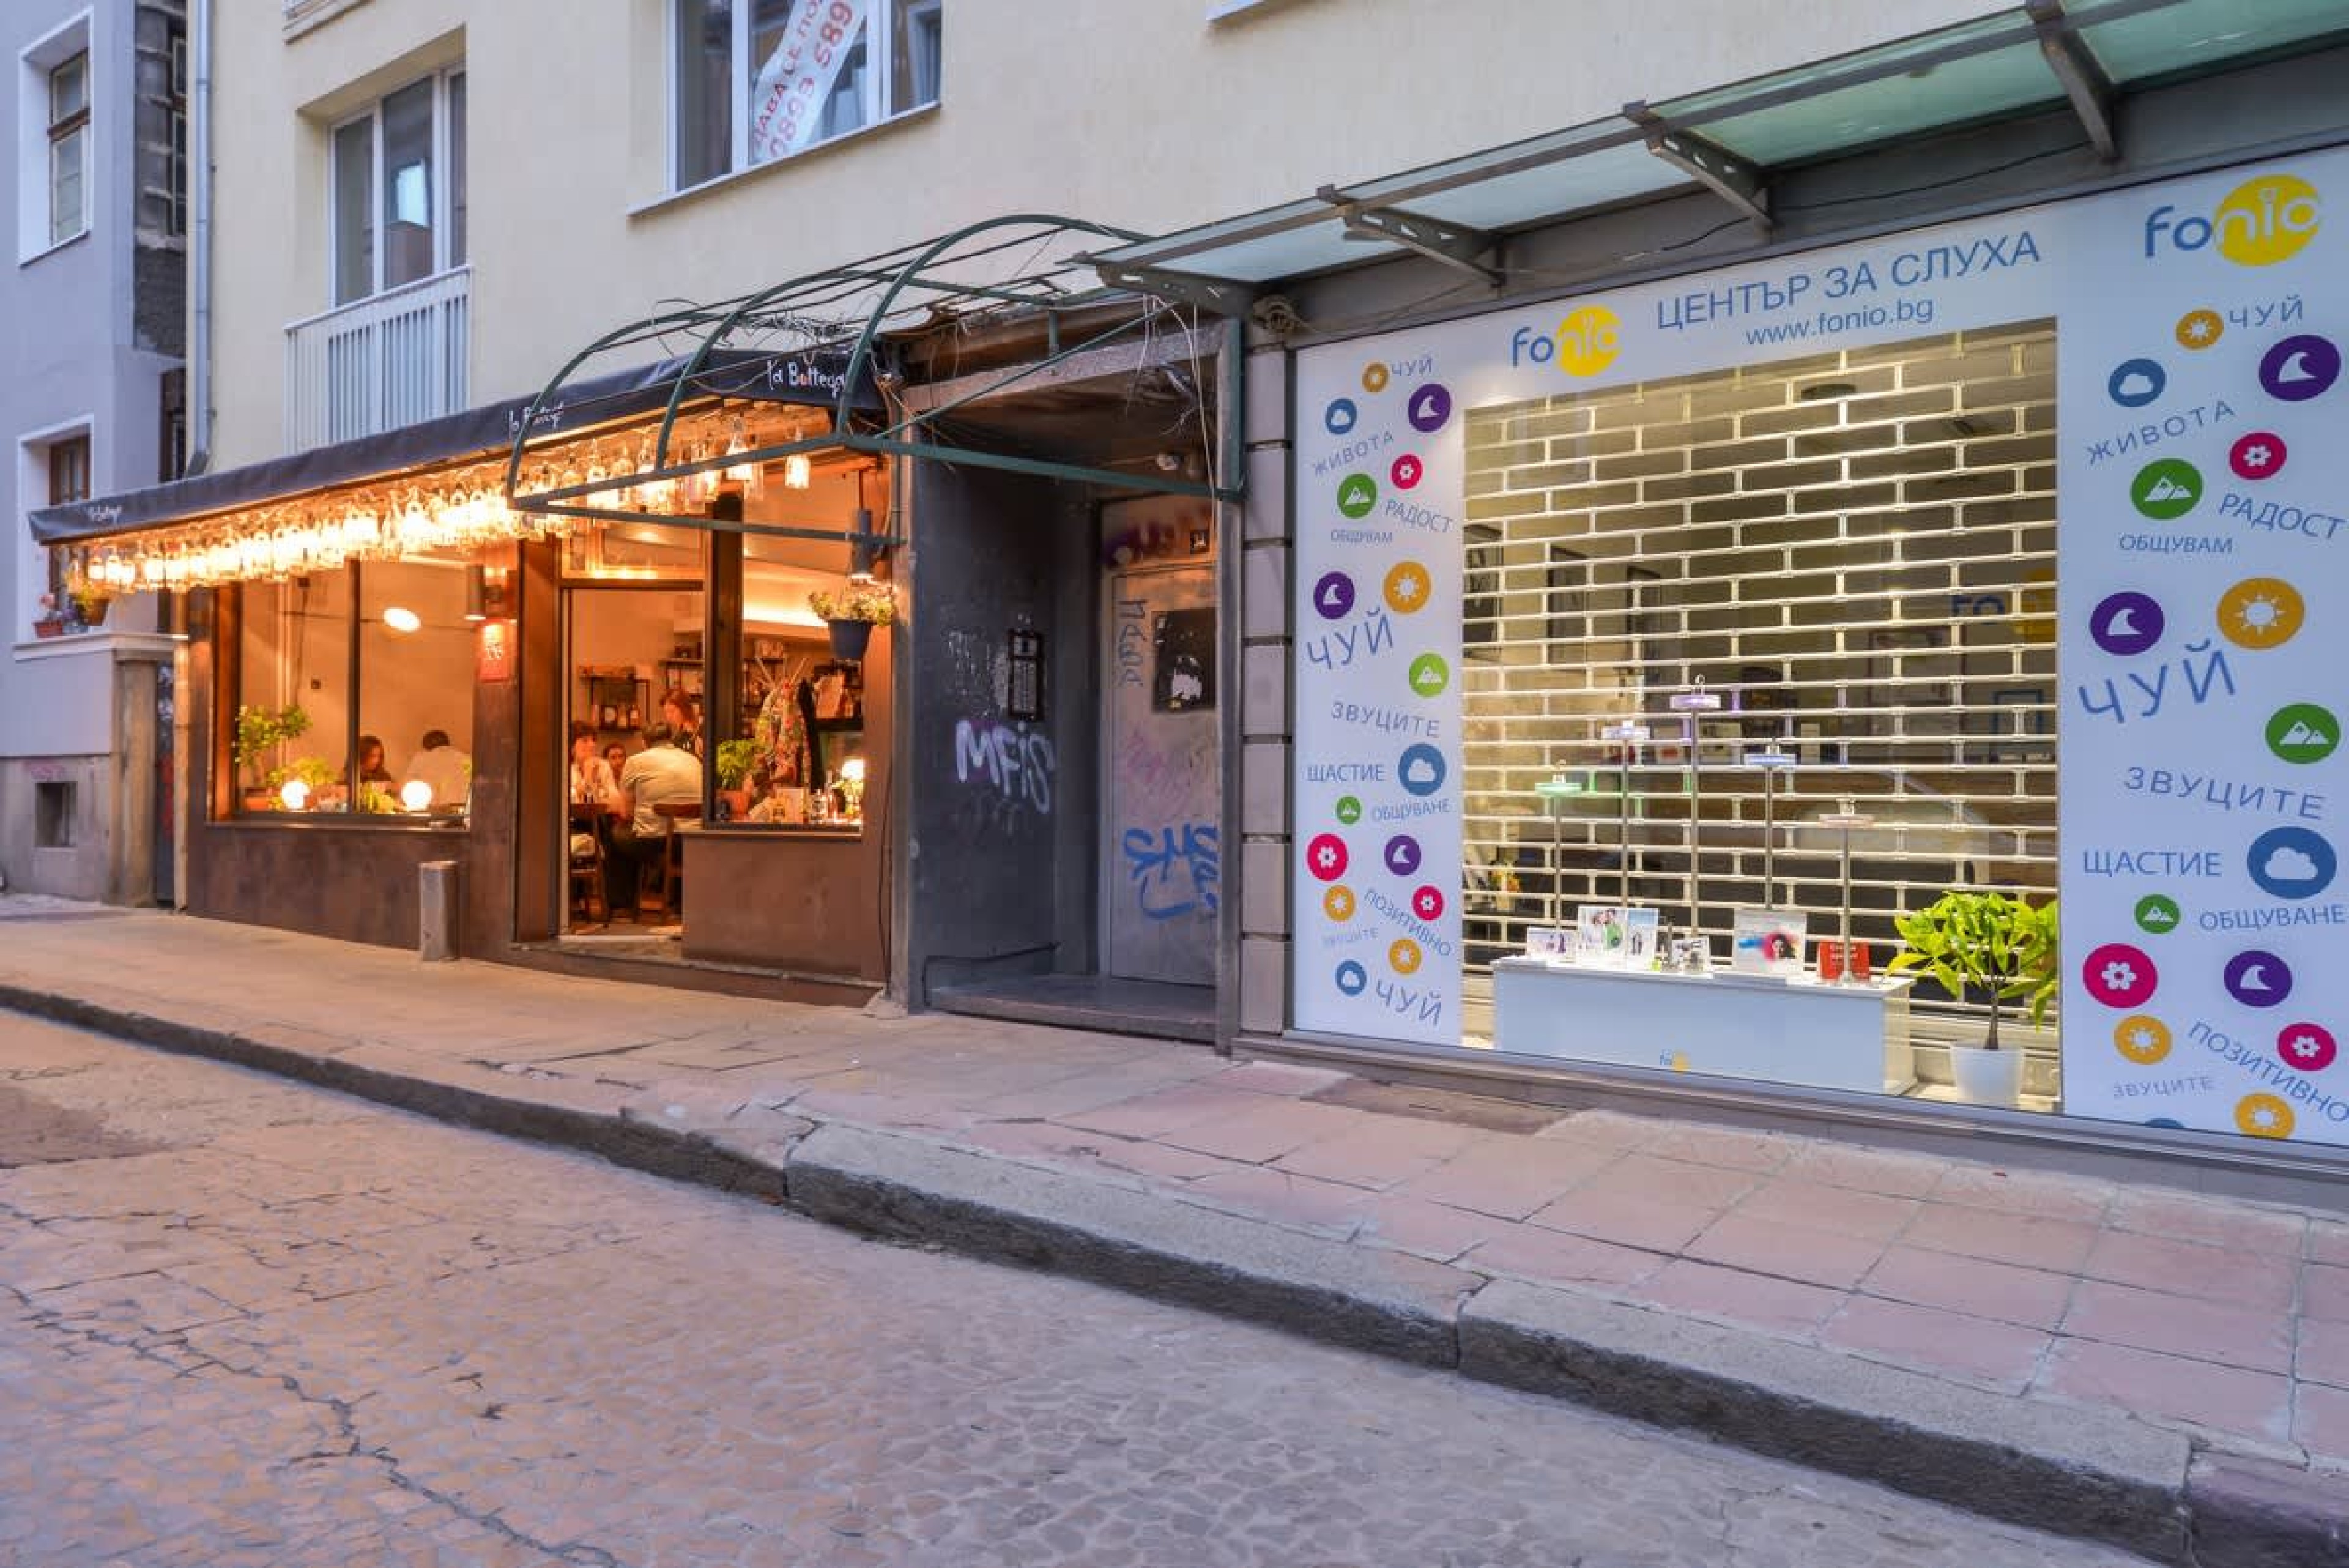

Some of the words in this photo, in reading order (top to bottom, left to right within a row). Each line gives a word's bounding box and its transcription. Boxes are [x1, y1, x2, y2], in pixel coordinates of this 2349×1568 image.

[2145, 185, 2320, 258] fonio
[1657, 274, 1811, 332] ЦЕНТЪР
[1824, 265, 1877, 299] ЗА
[1891, 230, 2041, 288] СЛУХА
[1745, 297, 1935, 347] www.fonio.bg
[2229, 293, 2303, 329] ЧУЙ
[1512, 310, 1622, 368] fonio
[1390, 357, 1433, 377] ЧУЙ
[1312, 430, 1394, 477] ЖИВОТА
[2087, 399, 2235, 466] ЖИВОТА
[1385, 499, 1453, 534] РАДОСТ
[2219, 492, 2347, 540] РАДОСТ
[2118, 533, 2233, 555] ОБЩУВАМ
[1307, 606, 1393, 670] ЧУЙ
[2078, 638, 2236, 723] ЧУЙ
[1331, 701, 1441, 738] ЗВУЦИТЕ
[1307, 764, 1386, 783] ЩАСТИЕ
[2124, 766, 2325, 820] ЗВУЦИТЕ
[1371, 797, 1451, 822] ОБЩУВАНЕ
[2083, 850, 2222, 877] ЩАСТИЕ
[1364, 889, 1452, 956] ПОЗИТИВНО
[2200, 904, 2346, 931] ОБЩУВАНЕ
[1375, 979, 1442, 1026] ЧУЙ
[2113, 1076, 2216, 1099] ЗВУЦИТЕ
[2188, 1021, 2349, 1123] ПОЗИТИВНО
